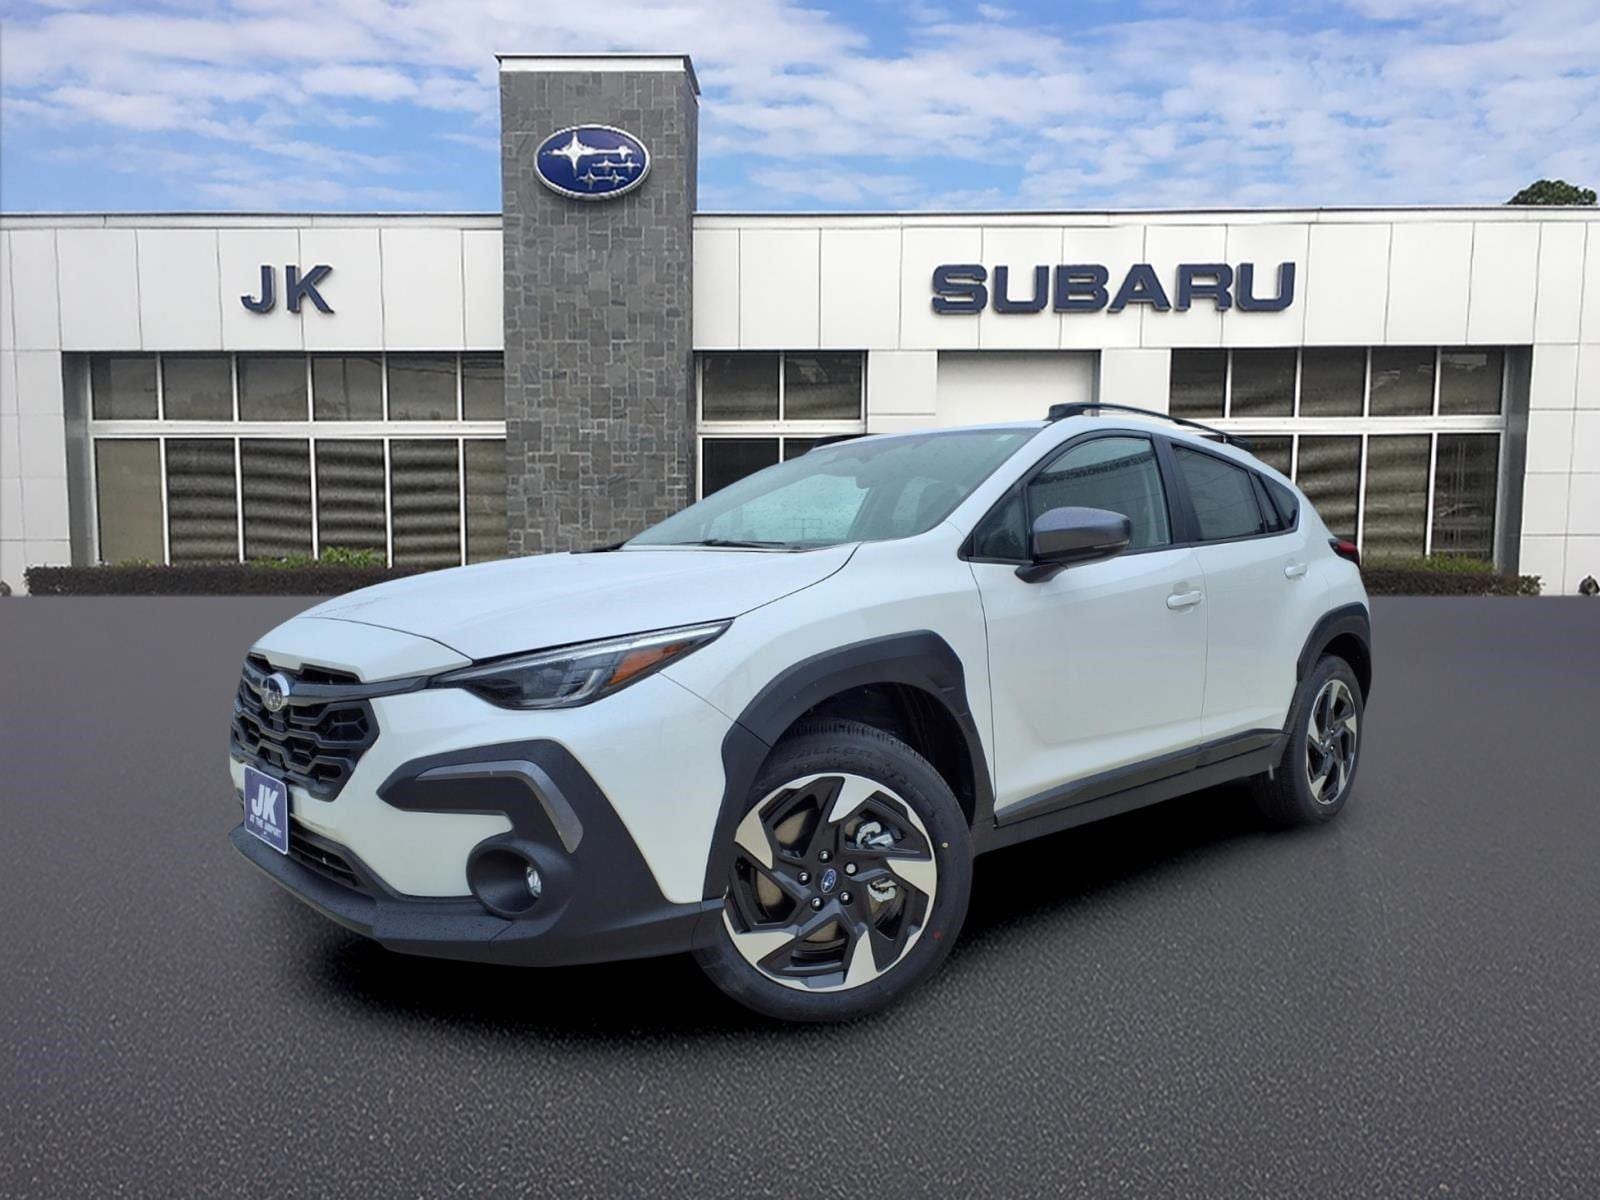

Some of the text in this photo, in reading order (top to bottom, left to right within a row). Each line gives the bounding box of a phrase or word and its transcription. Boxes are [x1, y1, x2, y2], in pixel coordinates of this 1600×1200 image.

[240, 264, 335, 314] JK
[931, 261, 1296, 315] SUBARU
[251, 784, 279, 826] JK
